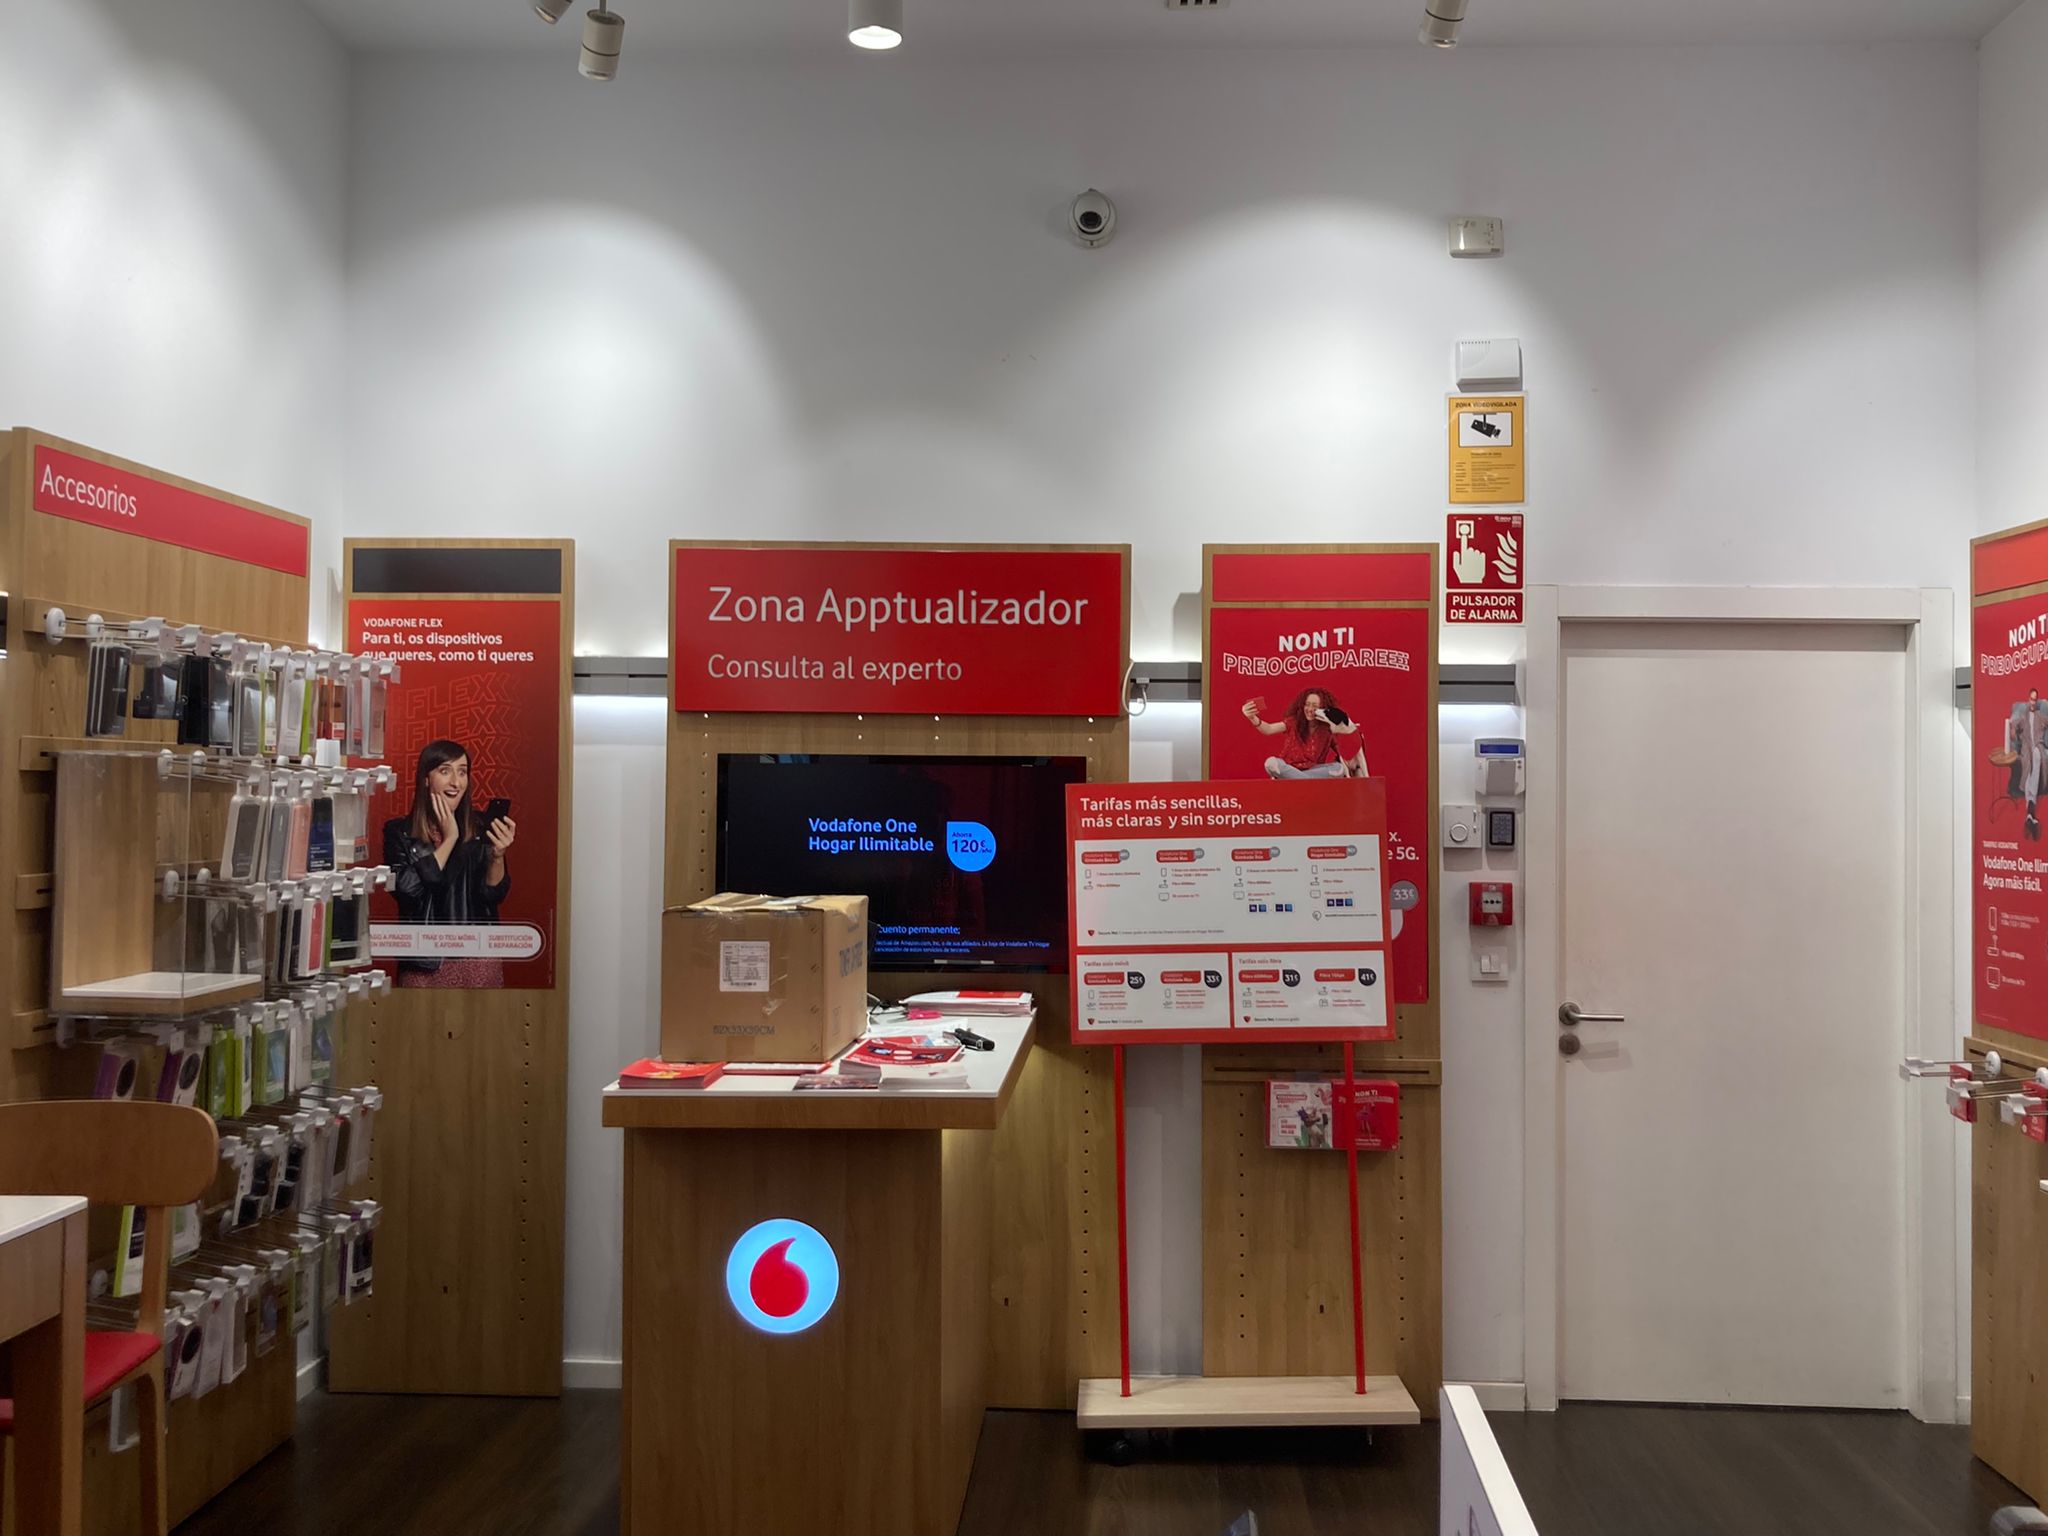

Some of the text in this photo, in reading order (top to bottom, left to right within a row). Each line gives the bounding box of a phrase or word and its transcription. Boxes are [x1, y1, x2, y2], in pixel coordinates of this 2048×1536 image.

[40, 463, 137, 517] Accesorios
[708, 586, 1089, 632] Zona Apptualizador
[1452, 596, 1516, 606] PULSADOR
[363, 617, 443, 628] VODAFONE FLEX
[1450, 609, 1518, 620] DE ALARMA
[362, 631, 503, 648] Para ti, os dispositivos
[1279, 627, 1354, 652] NON TI
[2009, 614, 2048, 648] NON T
[390, 650, 436, 663] queres,
[439, 651, 475, 662] como
[477, 649, 487, 661] ti
[489, 650, 534, 664] queres
[707, 654, 963, 685] Consulta al experto
[405, 672, 497, 719] FLEX
[1080, 795, 1242, 812] Tarifas más sencillas,
[808, 818, 917, 833] Vodafone One
[1081, 812, 1282, 829] más claras y sin sorpresas
[808, 836, 934, 854] Hogar Ilimitable
[1396, 847, 1420, 861] 5G.
[1983, 855, 2017, 871] Vodafone
[2018, 857, 2034, 872] One
[1983, 873, 2004, 890] Agora
